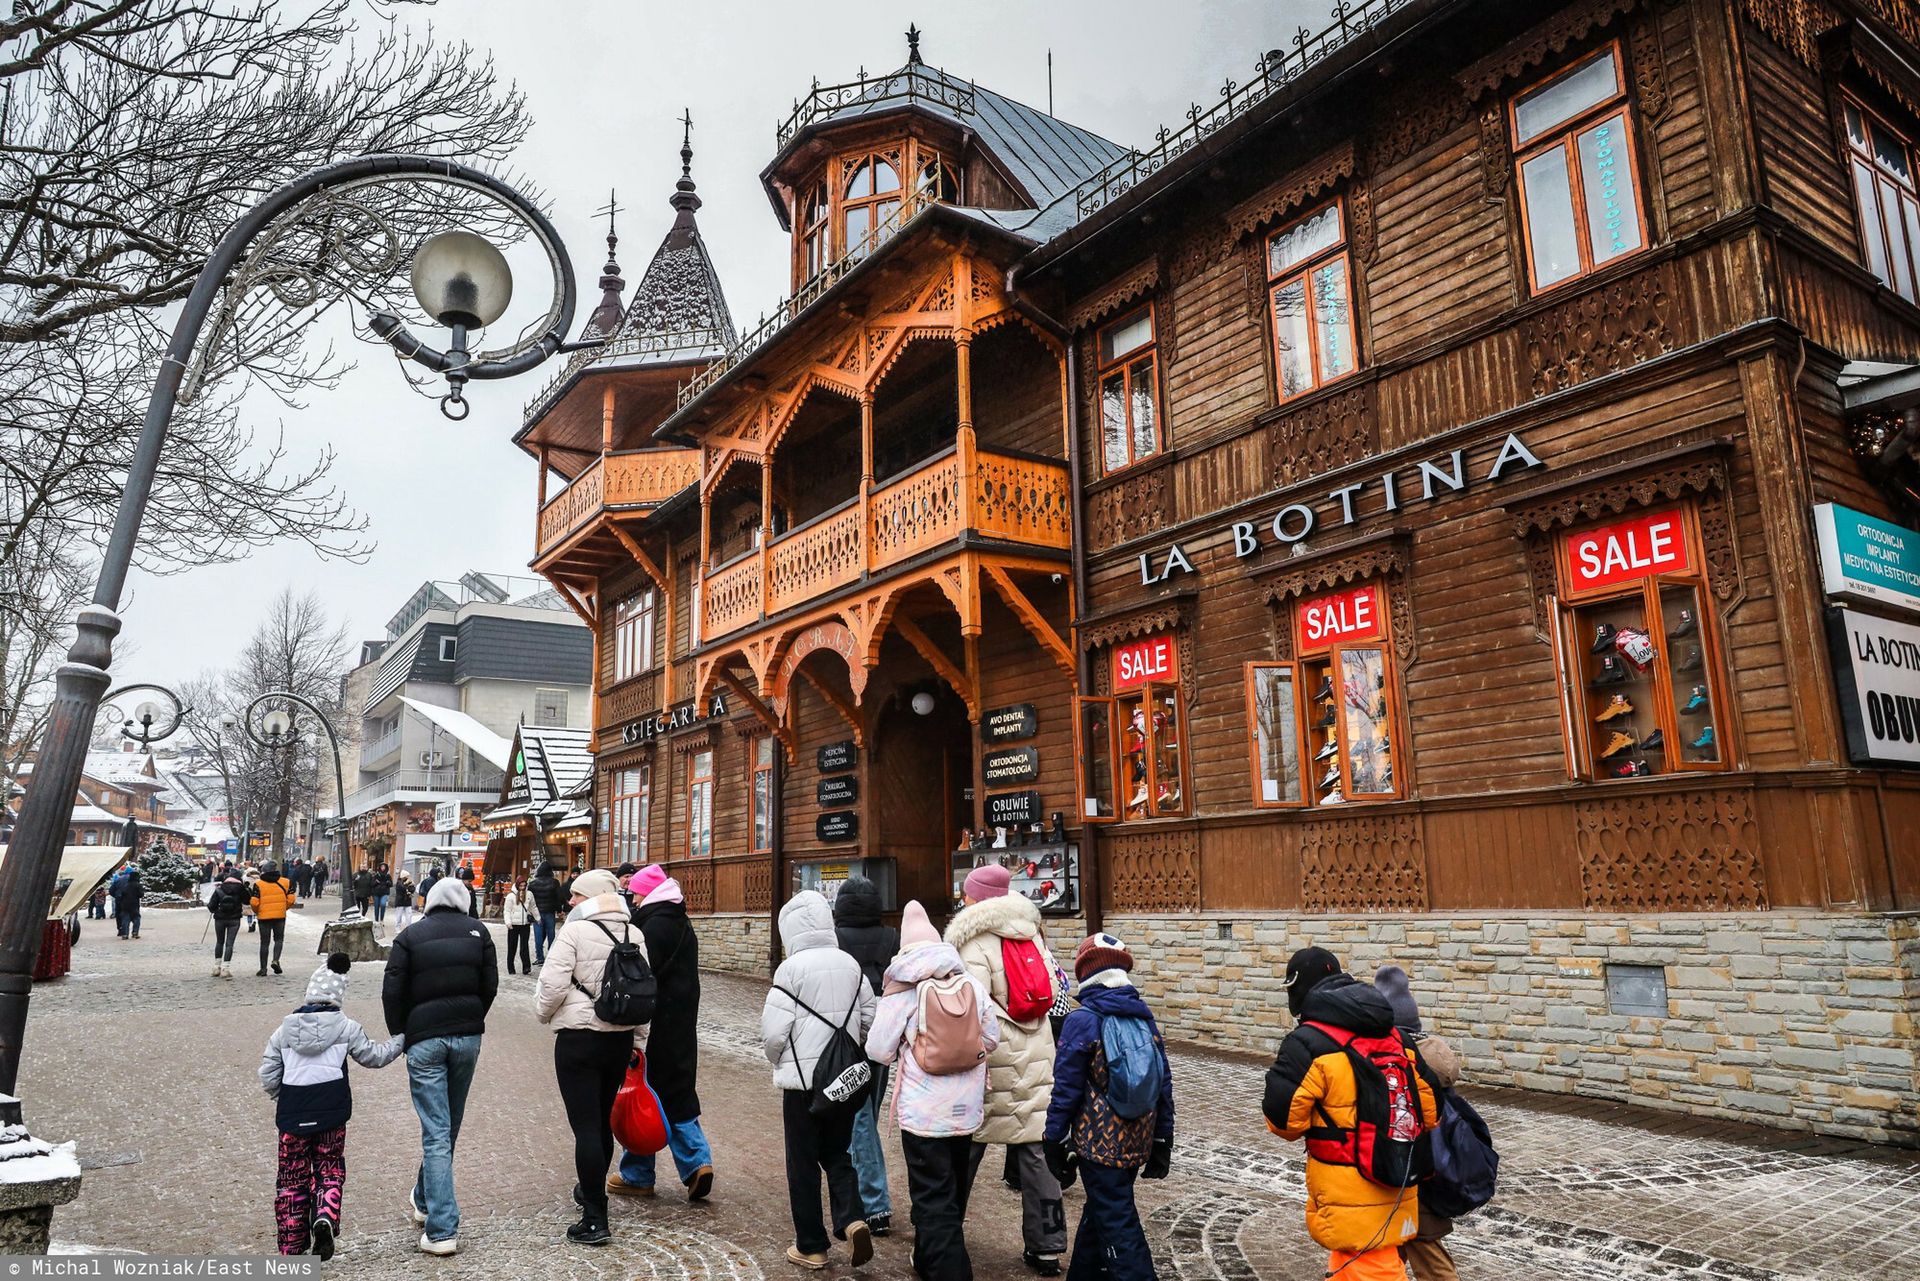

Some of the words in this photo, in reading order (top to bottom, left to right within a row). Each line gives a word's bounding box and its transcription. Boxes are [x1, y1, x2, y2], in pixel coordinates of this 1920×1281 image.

[1595, 127, 1626, 252] STOMATOLOGIA
[1138, 543, 1195, 586] LA
[1231, 432, 1545, 559] BOTINA
[1857, 523, 1905, 550] ORTODONCJA
[1578, 521, 1676, 579] SALE
[1866, 544, 1900, 565] IMPLANTY
[1843, 552, 1884, 576] MEDYCYNA
[1884, 565, 1920, 587] ESTETYCZ
[1306, 595, 1372, 640] SALE
[1854, 631, 1879, 664] LA
[1120, 644, 1168, 681] SALE
[622, 695, 725, 745] KSIĘGARA
[990, 715, 1003, 726] AVO
[1003, 711, 1025, 723] DENTAL
[993, 723, 1022, 736] IMPLANTY
[987, 764, 1032, 779] STOMATOLOGIA
[989, 754, 1029, 768] ORTODONCJA
[992, 797, 1029, 812] OBUWIE
[993, 813, 1001, 822] LA
[1003, 811, 1030, 821] BOTINA
[838, 1066, 857, 1085] VANS
[845, 1076, 859, 1092] THE
